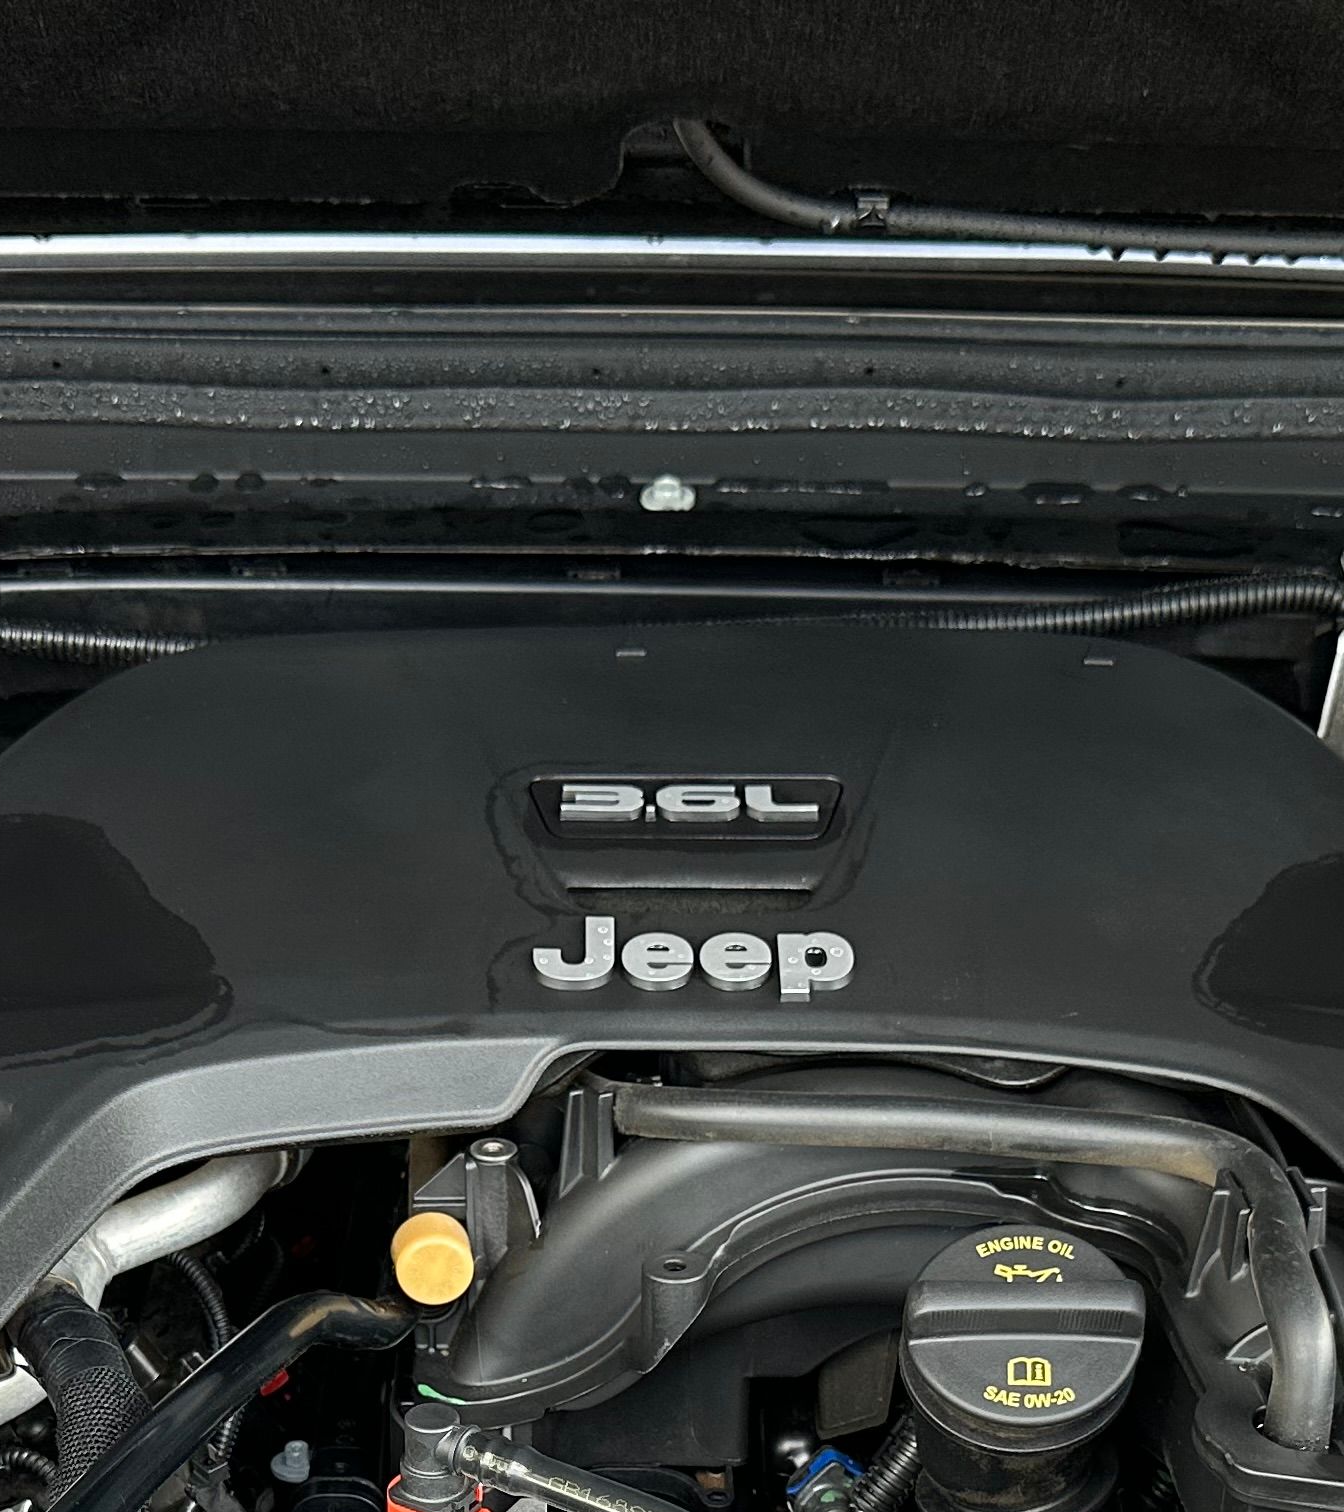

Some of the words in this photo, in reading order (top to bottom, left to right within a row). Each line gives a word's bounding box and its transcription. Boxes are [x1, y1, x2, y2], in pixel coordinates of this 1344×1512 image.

[559, 784, 821, 823] 3.6L
[532, 915, 855, 1003] Jeep
[975, 1236, 1045, 1258] ENGINE
[1048, 1239, 1075, 1260] OIL
[983, 1385, 1021, 1408] SAE
[1023, 1387, 1076, 1409] 0W-20
